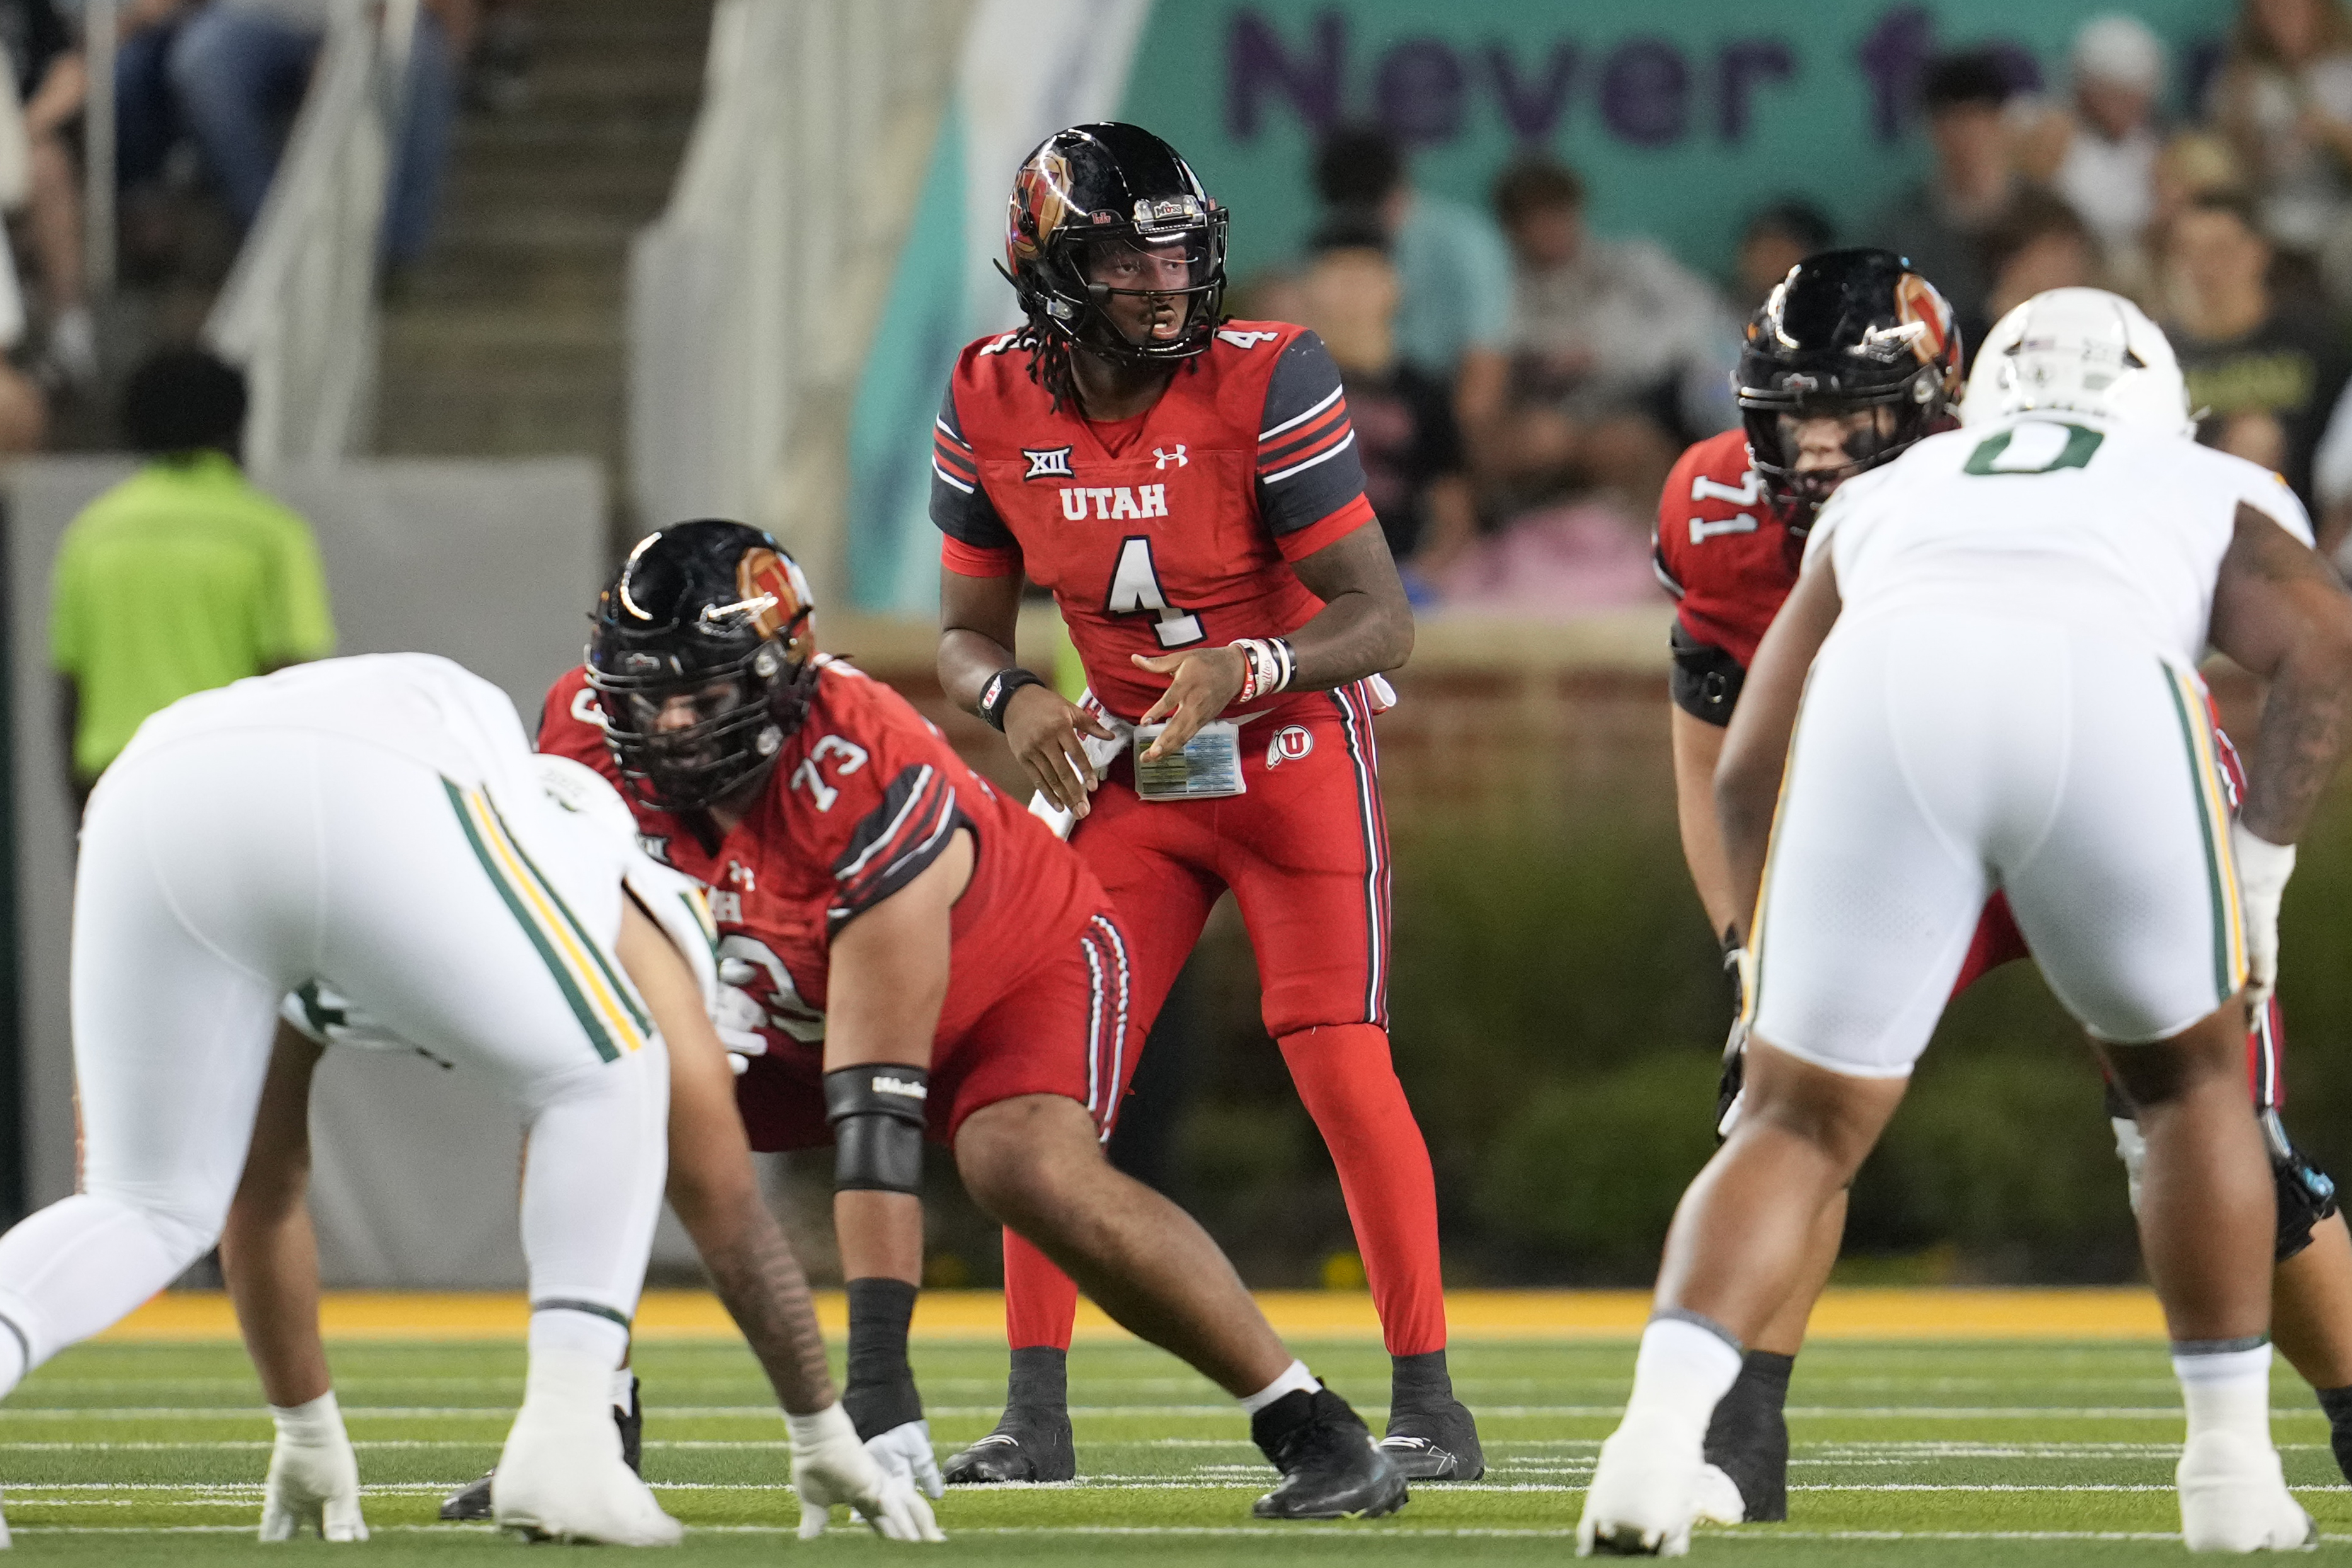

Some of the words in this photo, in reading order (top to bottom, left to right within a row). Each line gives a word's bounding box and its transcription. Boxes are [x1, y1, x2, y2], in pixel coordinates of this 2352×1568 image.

[1226, 10, 1796, 143] Never
[1217, 329, 1280, 350] 4
[1060, 484, 1168, 520] UTAH
[1689, 469, 1759, 546] 71
[1103, 535, 1207, 650] 4
[791, 734, 869, 812] 73
[1282, 732, 1304, 755] U
